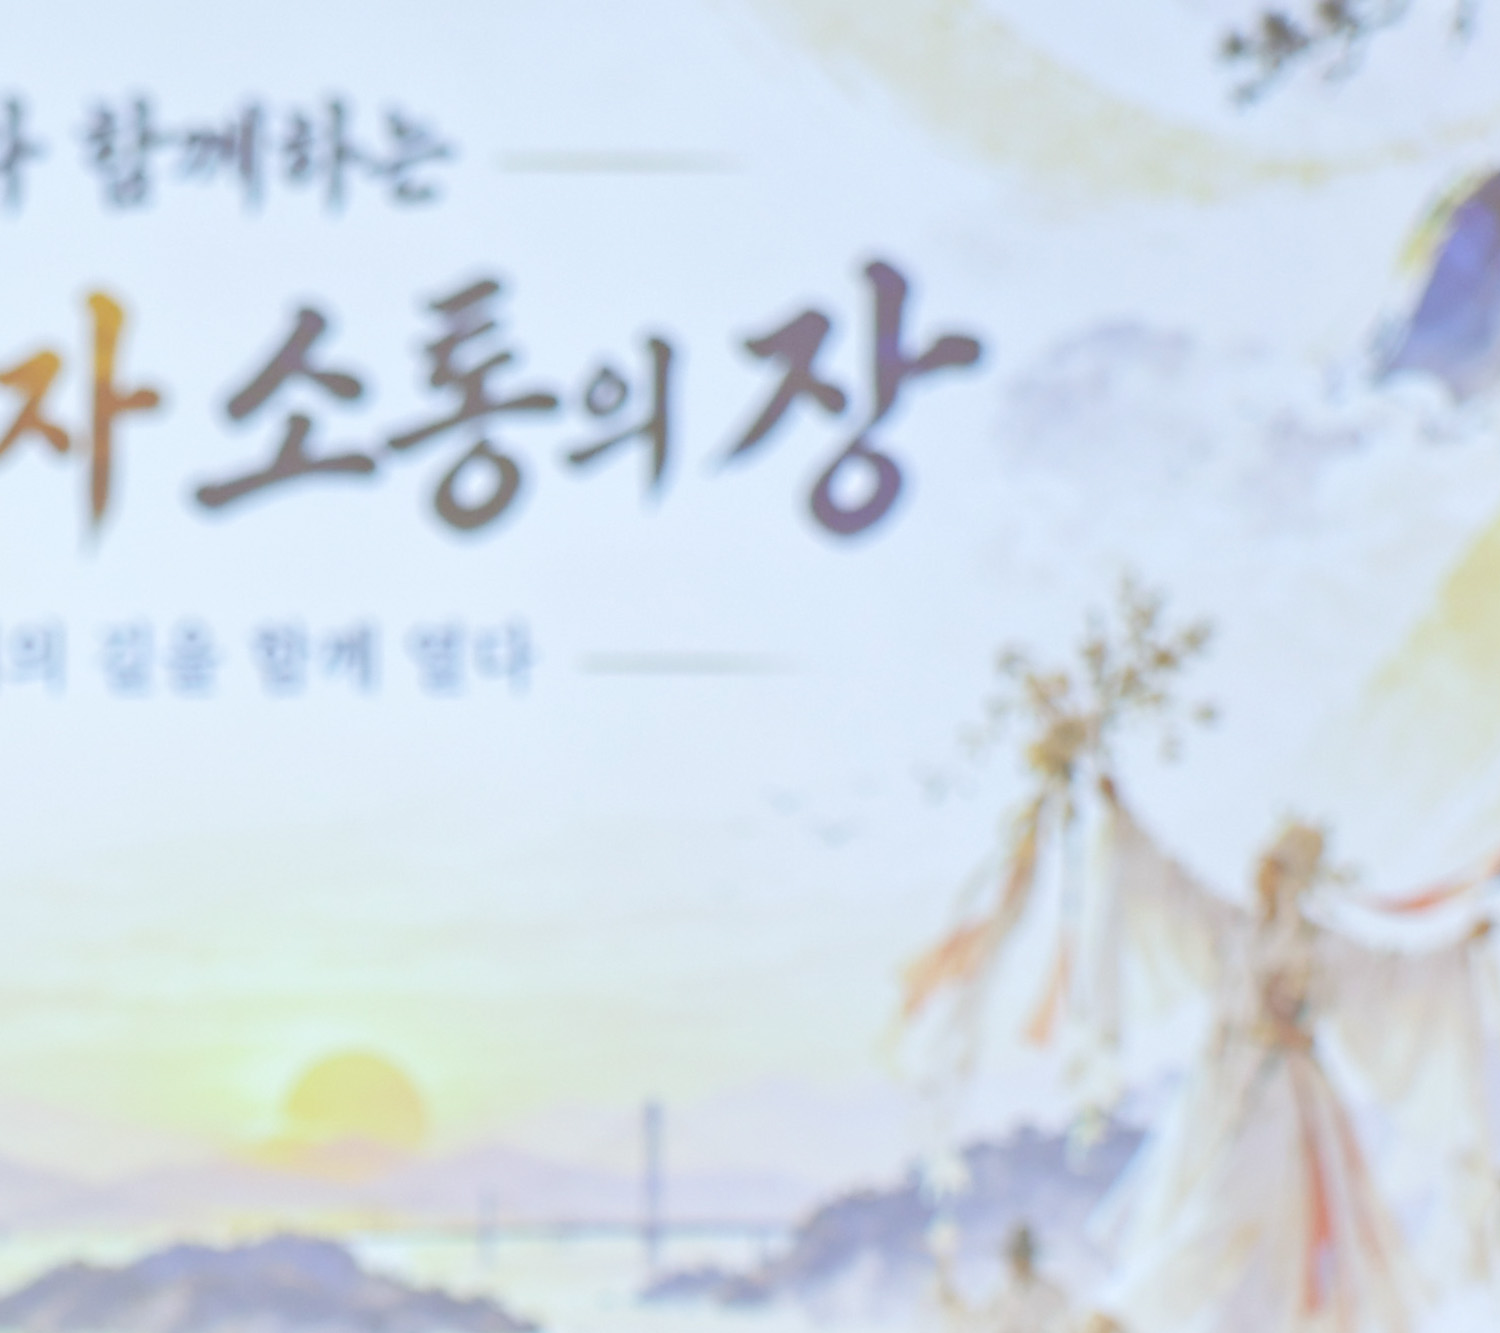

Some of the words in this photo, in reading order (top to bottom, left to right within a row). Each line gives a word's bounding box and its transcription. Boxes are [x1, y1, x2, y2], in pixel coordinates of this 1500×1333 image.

[80, 94, 456, 212] 함께하는
[191, 276, 679, 537] 소통의
[722, 257, 988, 542] 장
